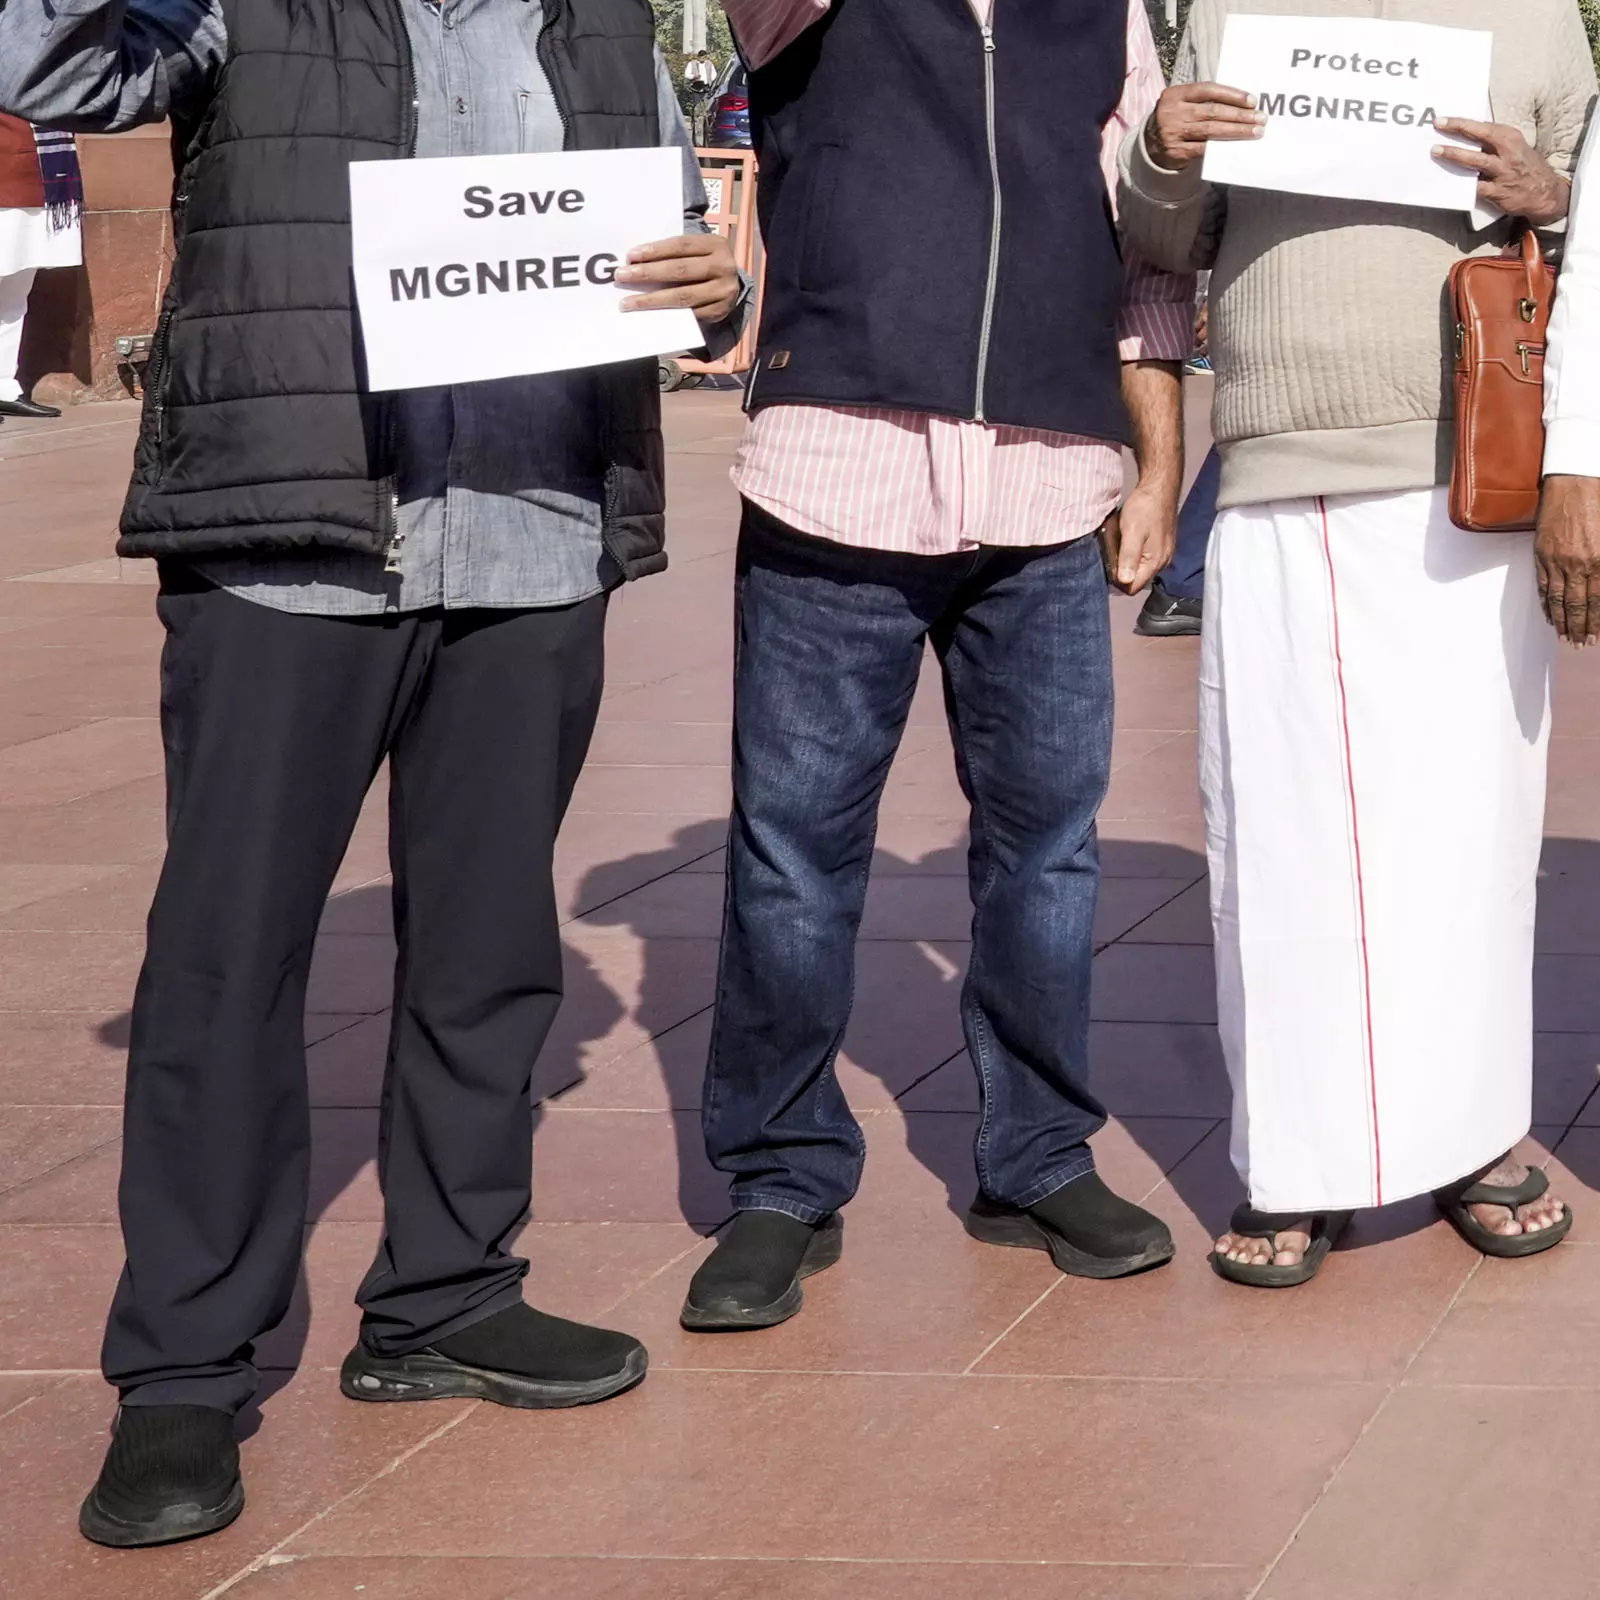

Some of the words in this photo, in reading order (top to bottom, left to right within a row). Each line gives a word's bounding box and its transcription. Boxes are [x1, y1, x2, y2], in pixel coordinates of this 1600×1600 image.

[1291, 49, 1419, 79] Protect
[1258, 90, 1437, 128] MGNREGA
[464, 186, 584, 218] Save
[389, 252, 619, 303] MGNREG
